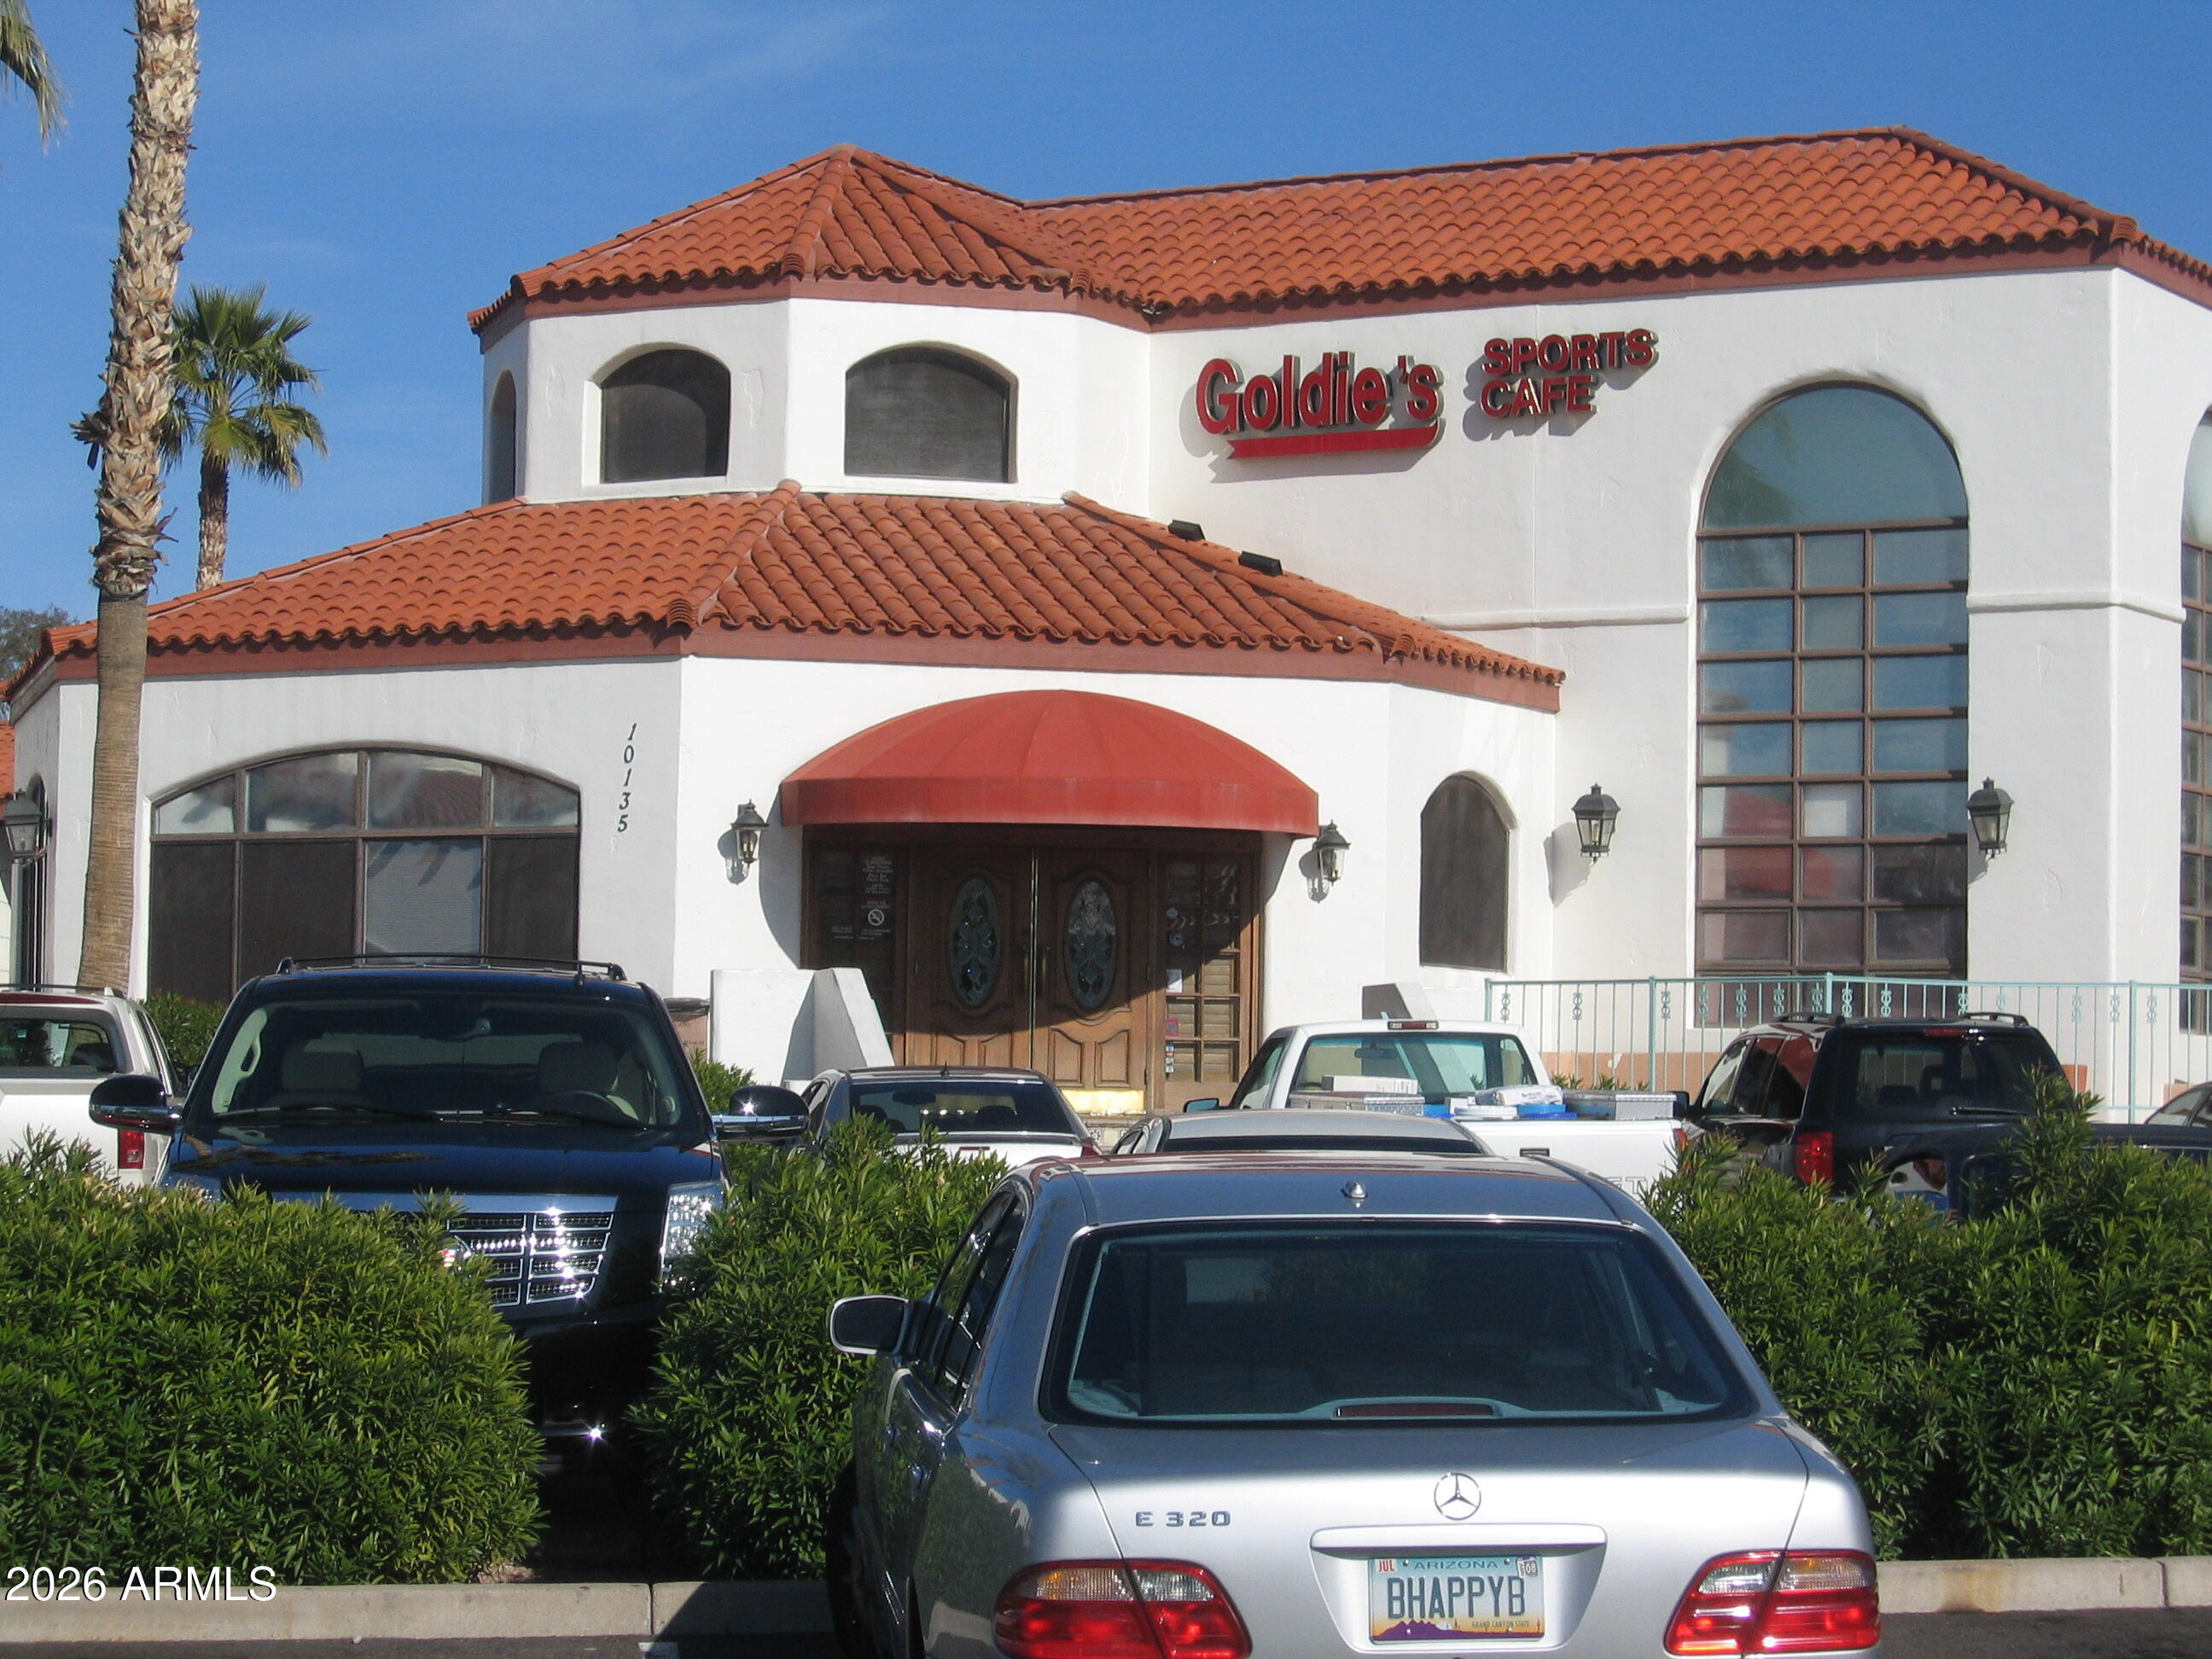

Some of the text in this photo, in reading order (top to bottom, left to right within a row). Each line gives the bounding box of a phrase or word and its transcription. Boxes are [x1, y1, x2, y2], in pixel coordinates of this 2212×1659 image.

[1481, 329, 1658, 375] SPORTS
[1196, 351, 1442, 434] Goldie's
[1479, 374, 1598, 418] CAFE
[617, 722, 637, 833] 10135
[1135, 1511, 1231, 1527] E 320
[1377, 1559, 1395, 1572] JUL
[1413, 1560, 1499, 1570] ARIZONA
[1387, 1575, 1526, 1619] BHAPPYB
